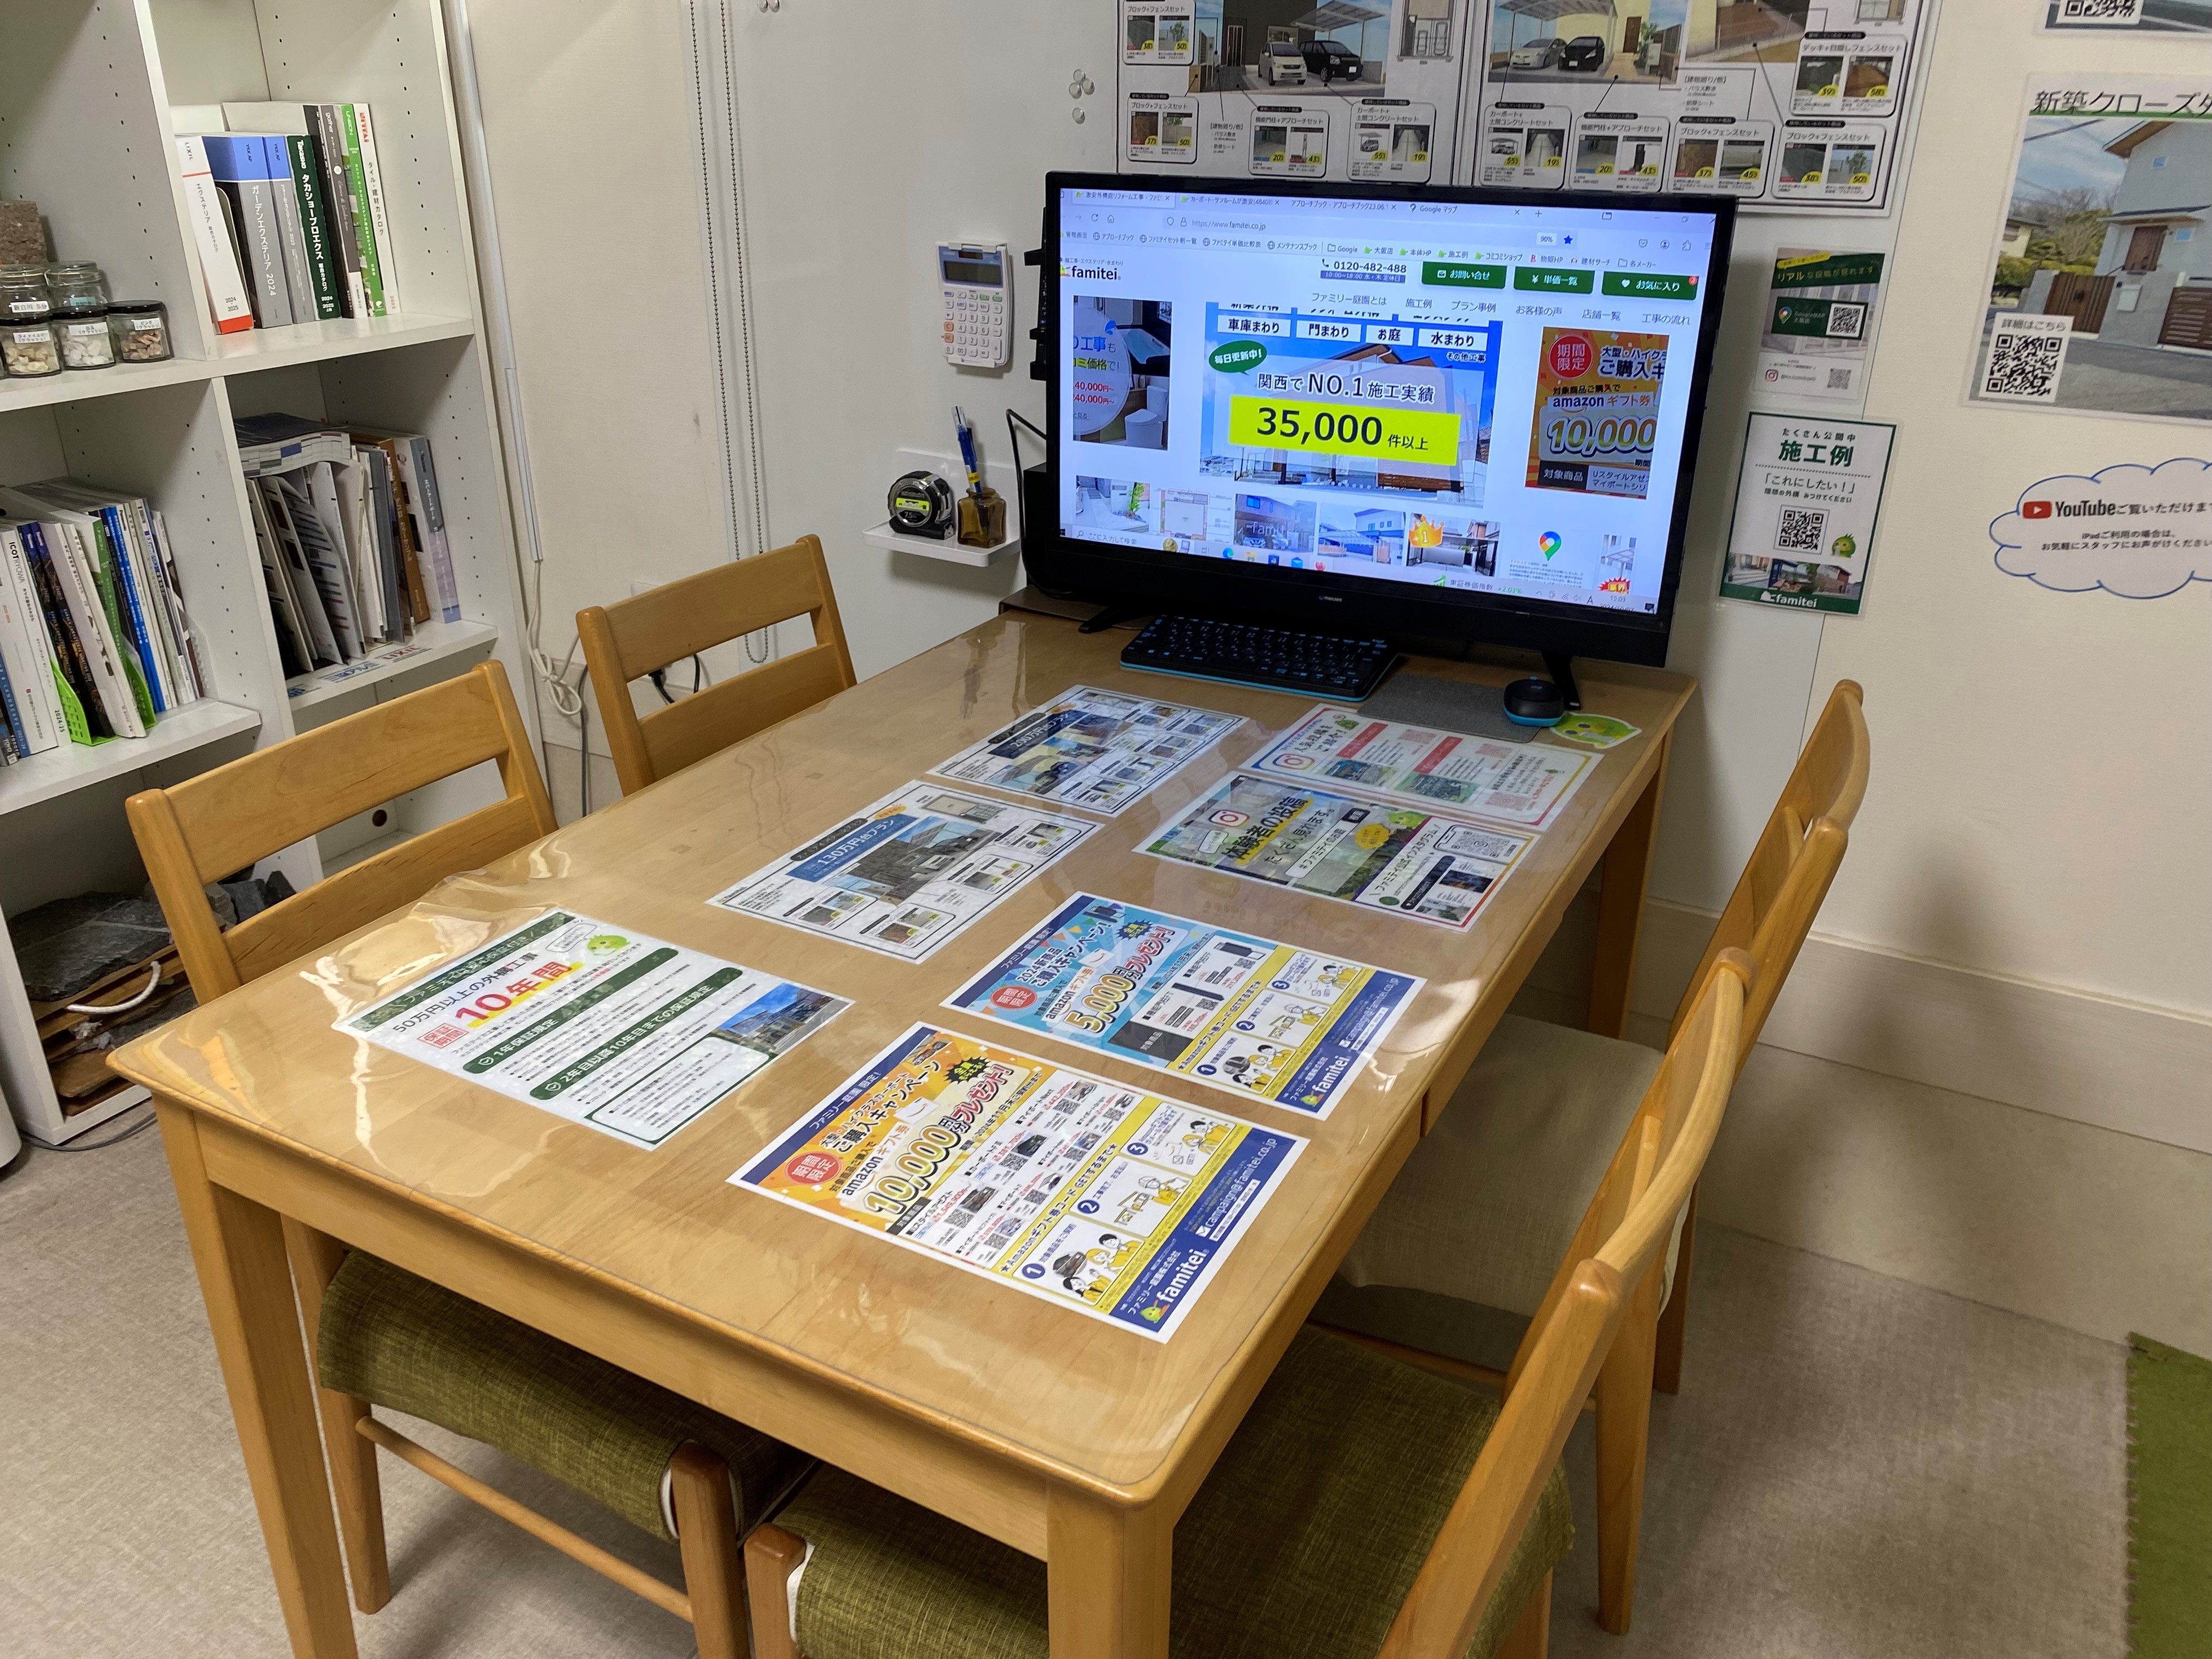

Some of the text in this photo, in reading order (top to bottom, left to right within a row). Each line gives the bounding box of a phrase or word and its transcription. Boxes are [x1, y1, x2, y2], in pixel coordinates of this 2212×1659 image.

[325, 112, 334, 133] gather
[359, 112, 369, 143] NITTAI
[184, 142, 194, 160] LIXIL
[196, 183, 211, 223] エクステリア
[368, 161, 383, 236] タイル・建材カタログ
[302, 174, 328, 291] タカショープロエクス 総合カタログ
[1192, 219, 1266, 230] https://www.famitei.co.jp
[251, 185, 276, 296] ガーデンエクステリア 2024
[1338, 245, 1358, 253] Google
[1486, 252, 1523, 261] コミコミショップ
[1071, 266, 1118, 280] famitei
[1334, 261, 1407, 273] 0120-482-488
[1450, 270, 1490, 280] お問い合せ
[1543, 275, 1577, 286] 単価一覧
[1636, 280, 1680, 291] お気に入り
[1312, 292, 1387, 306] ファミリー庭園とは
[1406, 298, 1432, 309] 施工例
[1451, 301, 1497, 313] プラン事例
[1516, 305, 1562, 317] お客様の声
[1582, 309, 1621, 321] 店舗一覧
[1642, 313, 1691, 325] 工事の流れ
[1228, 318, 1280, 334] 車庫まわり
[1308, 323, 1349, 338] 門まわり
[2001, 318, 2066, 332] 詳細はこちら
[1378, 328, 1401, 342] お庭
[1431, 332, 1474, 347] 水まわり
[1557, 343, 1585, 358] 期間
[1557, 357, 1586, 371] 限定
[1553, 394, 1651, 408] amazon ギフト券
[1256, 407, 1429, 450] 35,000 件以上
[1548, 417, 1656, 455] 10,000
[1782, 427, 1856, 442] たくさん公開中
[1779, 440, 1854, 467] 施工例
[1544, 469, 1583, 482] 対象商品
[1088, 533, 1137, 545] ここに入力して検索
[1421, 531, 1429, 543] 1
[9, 541, 25, 584] ICOTRYOWA
[1498, 586, 1522, 594] +2.03%
[1774, 593, 1818, 608] famitei
[1218, 795, 1311, 860] 体験者の投稿
[1261, 806, 1337, 865] たくさん見れます。
[815, 817, 898, 865] 130万円台プラン
[1000, 938, 1041, 969] ファミリー庭園
[1015, 946, 1063, 983] 2024新商品
[388, 952, 543, 1032] 50万円以上の外構工事
[448, 960, 576, 1025] 10年間
[994, 987, 1022, 1005] 期間
[1006, 990, 1034, 1008] 限定
[1027, 980, 1075, 1017] 対象商品ご購入で
[1040, 967, 1098, 1020] amazon ギフト券
[1342, 977, 1401, 1041] campaign@famitei.co.jp
[420, 1024, 456, 1042] 保証
[431, 1028, 468, 1047] 期間
[490, 1018, 560, 1058] 1年保証規定
[558, 985, 714, 1083] 2年目以降10年目までの保証規定
[1310, 1054, 1352, 1093] famitei
[807, 1086, 864, 1130] ファミリー庭園
[817, 1071, 911, 1147] 大型・ハイクラスカーポート
[828, 1059, 946, 1154] ご購入キャンペーン
[1129, 1144, 1147, 1153] 3
[789, 1154, 825, 1178] 期間
[819, 1141, 886, 1192] 対象商品ご購入で
[834, 1122, 916, 1197] amazon ギフト券
[803, 1158, 839, 1182] 限定
[1201, 1137, 1279, 1228] campaign@famitei.co.jp
[895, 1203, 926, 1227] 対象商品
[1080, 1201, 1097, 1211] 2
[1024, 1266, 1042, 1276] 1
[1153, 1248, 1209, 1304] famitei
[1126, 1250, 1183, 1316] ファミリー庭園株式会社
